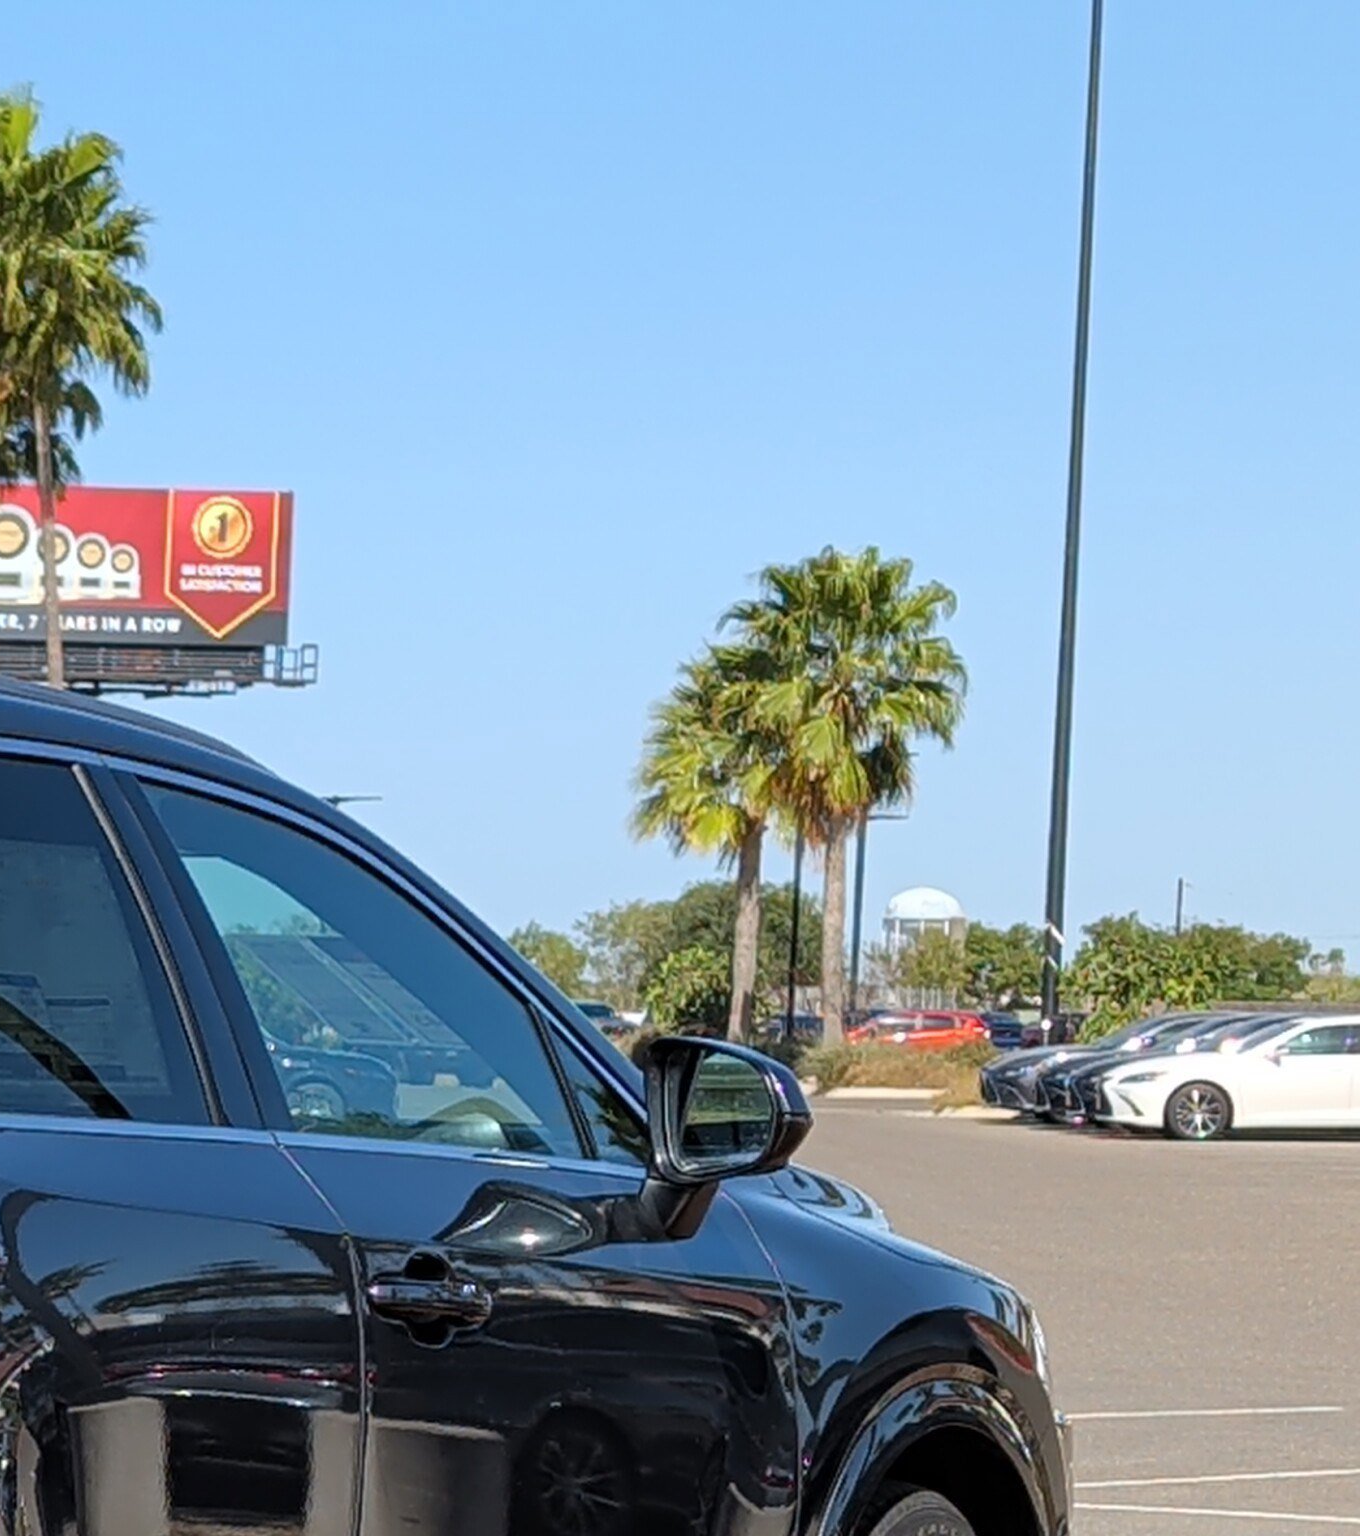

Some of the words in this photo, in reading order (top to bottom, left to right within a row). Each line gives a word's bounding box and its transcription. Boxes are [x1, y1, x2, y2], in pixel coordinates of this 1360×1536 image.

[28, 614, 40, 629] 7
[42, 614, 98, 631] ARS
[101, 616, 121, 632] IN
[124, 616, 137, 632] A
[141, 616, 182, 633] ROW
